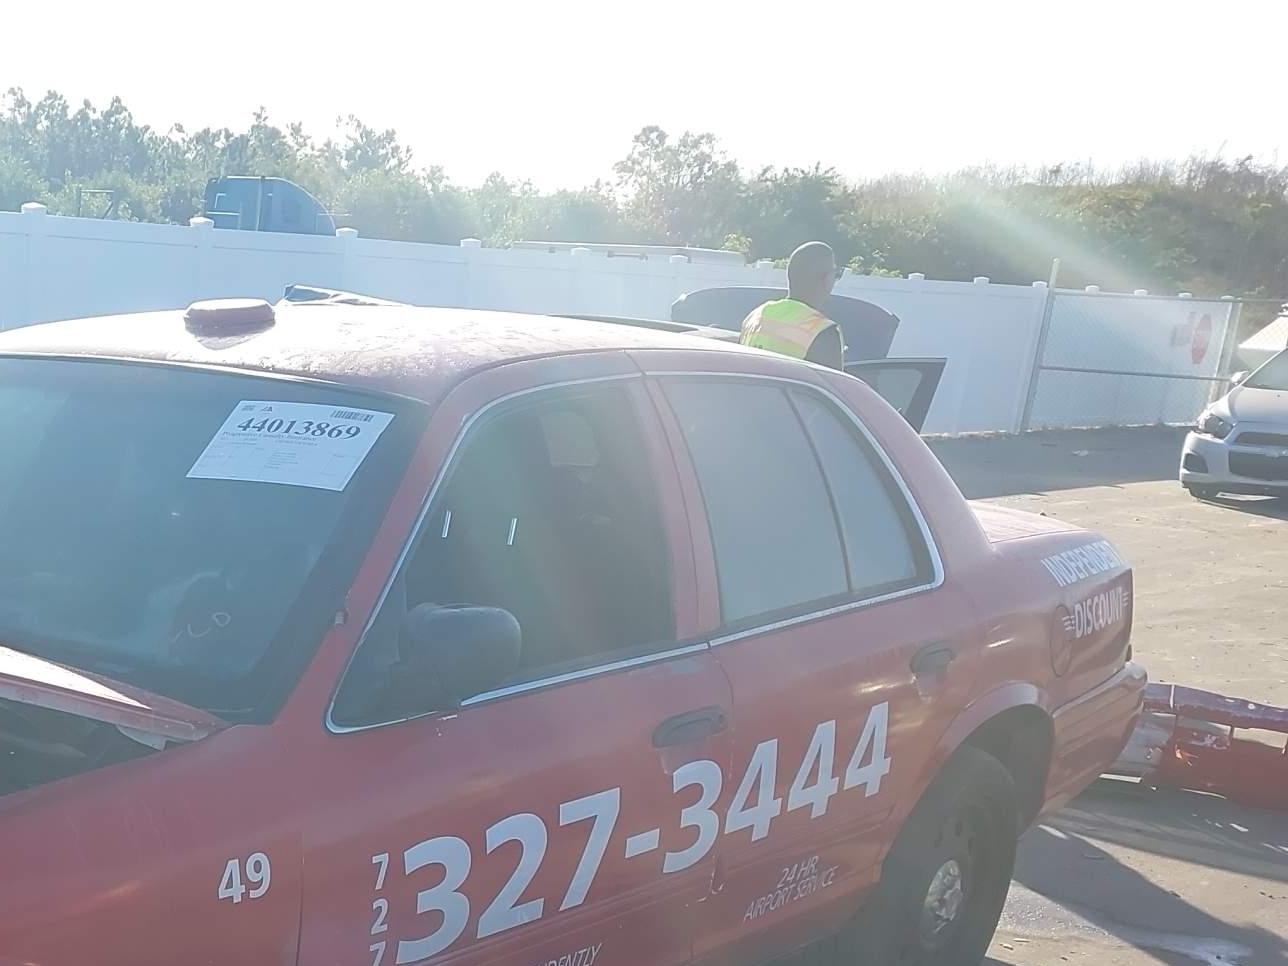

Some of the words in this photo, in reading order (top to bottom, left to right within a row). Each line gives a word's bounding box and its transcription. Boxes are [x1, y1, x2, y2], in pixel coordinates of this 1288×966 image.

[237, 417, 361, 440] 44013869
[1074, 587, 1123, 638] DISCOUNT
[396, 701, 892, 965] 327-3444
[218, 851, 272, 904] 49
[776, 863, 799, 889] 24
[797, 855, 820, 881] HR
[743, 885, 795, 924] AIRPORT
